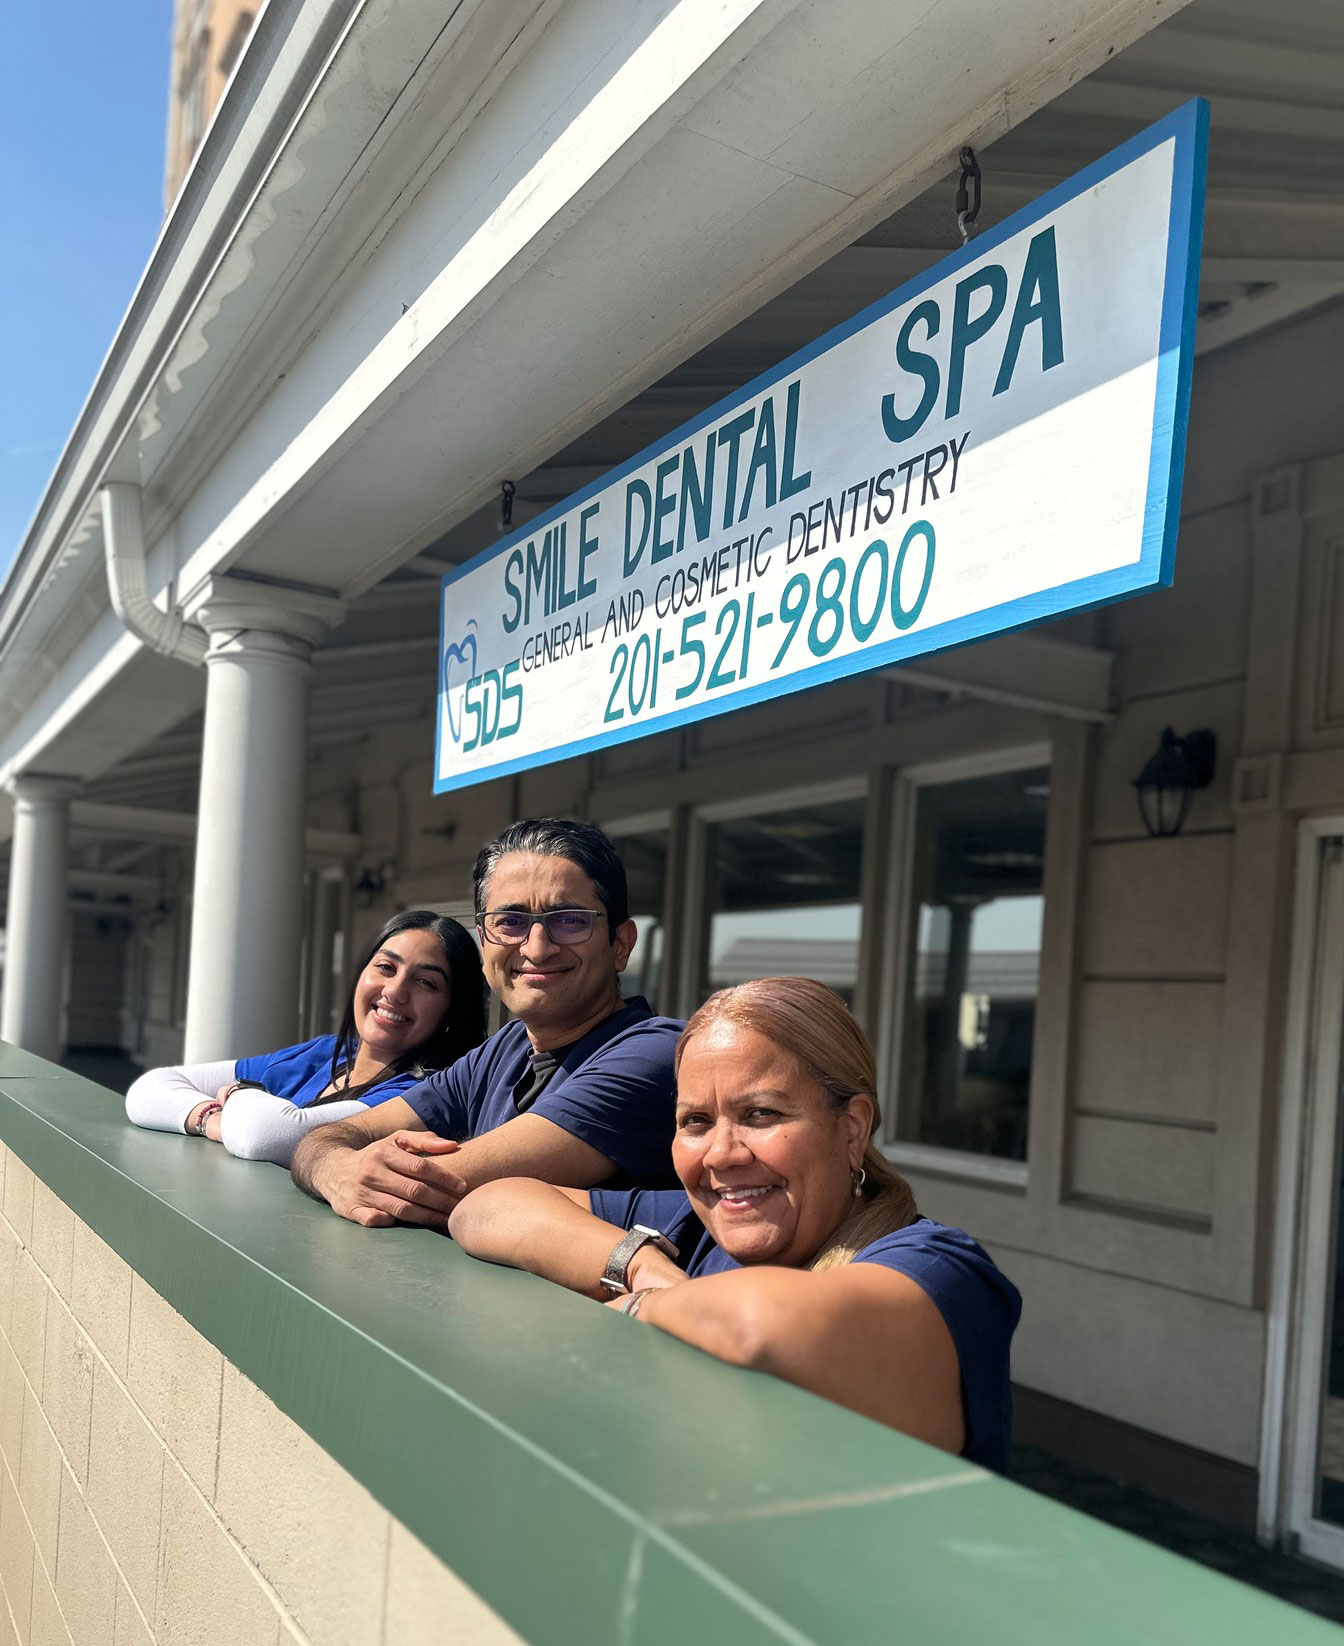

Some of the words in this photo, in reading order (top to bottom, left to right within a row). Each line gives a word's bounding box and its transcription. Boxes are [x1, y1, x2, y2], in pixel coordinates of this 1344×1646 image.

[502, 501, 600, 634] SMILE
[622, 380, 812, 579] DENTAL
[881, 225, 1064, 443] SPA
[522, 611, 593, 673] GENERAL
[601, 588, 644, 644] AND
[655, 526, 773, 619] COSMETIC
[786, 431, 971, 564] DENTISTRY
[603, 519, 936, 723] 201-521-9800
[462, 657, 524, 753] SDS
